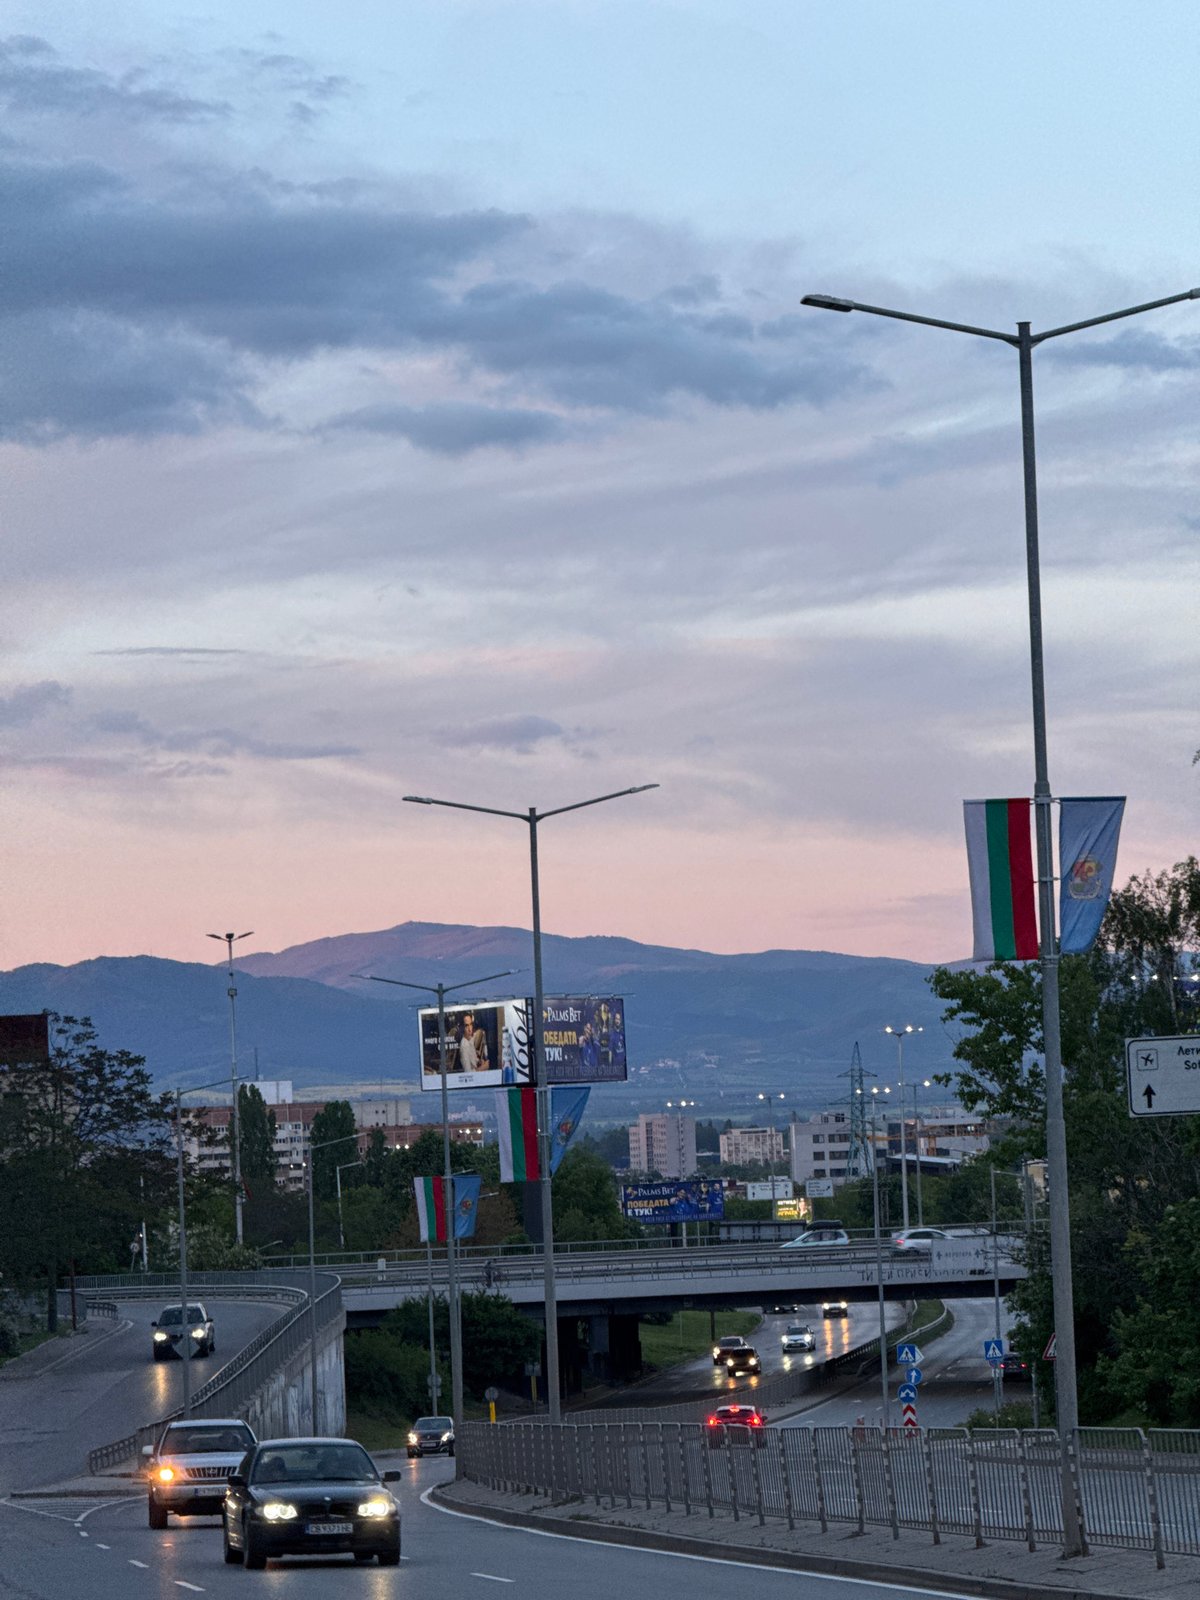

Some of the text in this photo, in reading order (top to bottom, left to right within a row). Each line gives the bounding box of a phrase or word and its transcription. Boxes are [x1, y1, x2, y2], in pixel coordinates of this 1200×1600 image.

[511, 1002, 529, 1078] 1664
[543, 1030, 578, 1046] ОБЕДАТА
[627, 1198, 669, 1209] ПОБЕДАТА
[634, 1207, 653, 1217] ТУК!
